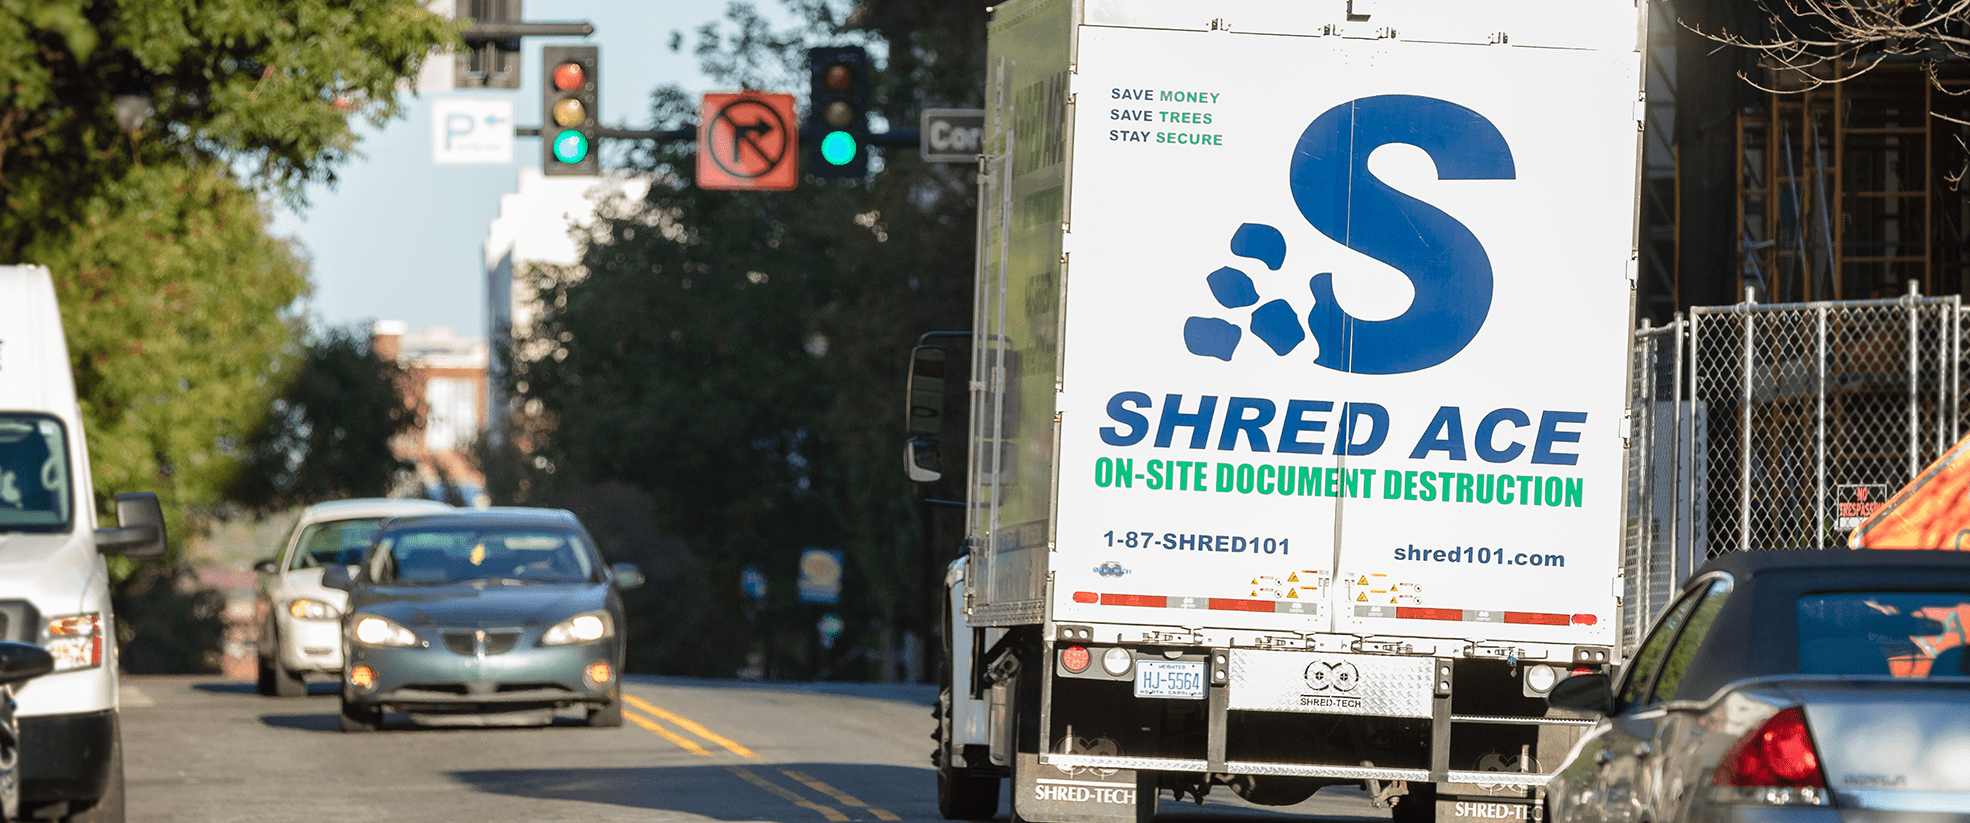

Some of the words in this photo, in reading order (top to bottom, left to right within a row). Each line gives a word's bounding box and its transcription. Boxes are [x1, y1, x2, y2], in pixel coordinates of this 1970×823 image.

[1111, 88, 1154, 101] SAVE
[1160, 90, 1220, 104] MONEY
[1110, 109, 1153, 122] SAVE
[1159, 111, 1213, 124] TREES
[1109, 130, 1151, 142] STAY
[1156, 132, 1223, 146] SECURE
[1099, 391, 1390, 456] SHRED
[1408, 406, 1588, 466] ACE
[1095, 457, 1207, 492] ON-SITE
[1216, 462, 1376, 498] DOCUMENT
[1383, 470, 1583, 508] DESTRUCTION
[1857, 487, 1868, 501] NO
[1839, 502, 1886, 517] TRESPASSI
[1104, 530, 1289, 555] 1-87-SHRED101
[1394, 544, 1565, 567] shred101.com
[1143, 671, 1199, 690] HJ-5564
[1300, 697, 1361, 708] SHRED-TECH
[1035, 784, 1136, 805] SHRED-TECH
[1455, 801, 1543, 821] SHRED-TEC
